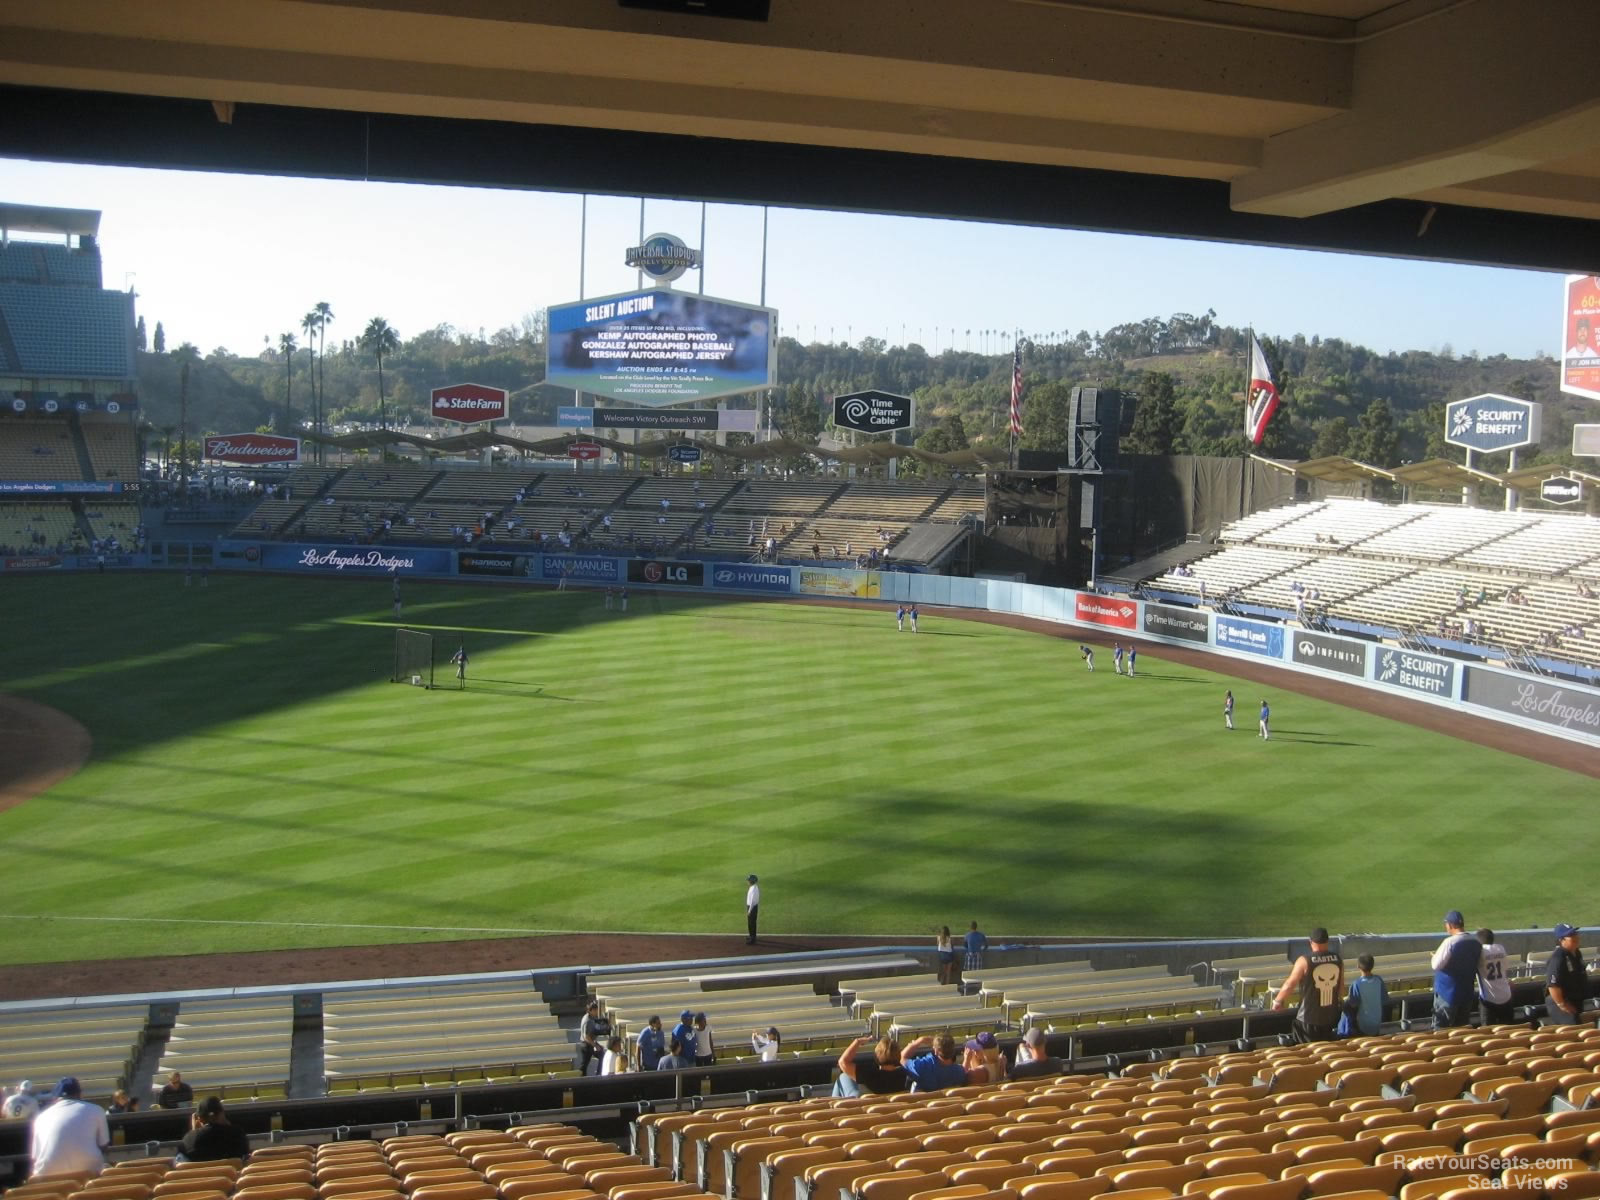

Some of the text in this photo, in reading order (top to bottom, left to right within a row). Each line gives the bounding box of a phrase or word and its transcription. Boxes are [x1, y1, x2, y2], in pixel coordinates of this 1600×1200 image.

[626, 245, 695, 261] UNIVERSAL STUDIOS
[586, 295, 654, 322] SILENT AUCTION
[598, 332, 718, 341] KEMP AUTOGRAPHED PHOTO
[582, 341, 734, 351] GONZALEZ AUTOGRAPHED BASEBALL
[589, 351, 726, 360] KERSHAW AUTOGRAPHED JERSEY
[871, 399, 893, 408] Time
[870, 408, 903, 417] Warner
[603, 414, 635, 423] Welcome
[636, 415, 658, 425] Victory
[659, 415, 691, 424] Outreach
[870, 416, 896, 425] Cable
[207, 440, 295, 457] Budweiser
[299, 549, 414, 571] Los Angeles Dodgers
[544, 559, 616, 571] SAN MANUEL
[666, 566, 688, 581] LG
[738, 573, 789, 585] HYUNDAI
[1078, 602, 1091, 612] Bank
[1098, 606, 1119, 617] America
[1153, 614, 1206, 632] Time Warner Cable
[1228, 626, 1248, 639] Merrill
[1249, 630, 1266, 642] Lynch
[1511, 683, 1600, 728] Los Angeles
[1311, 955, 1338, 963] CASTLE
[1487, 961, 1503, 980] 21
